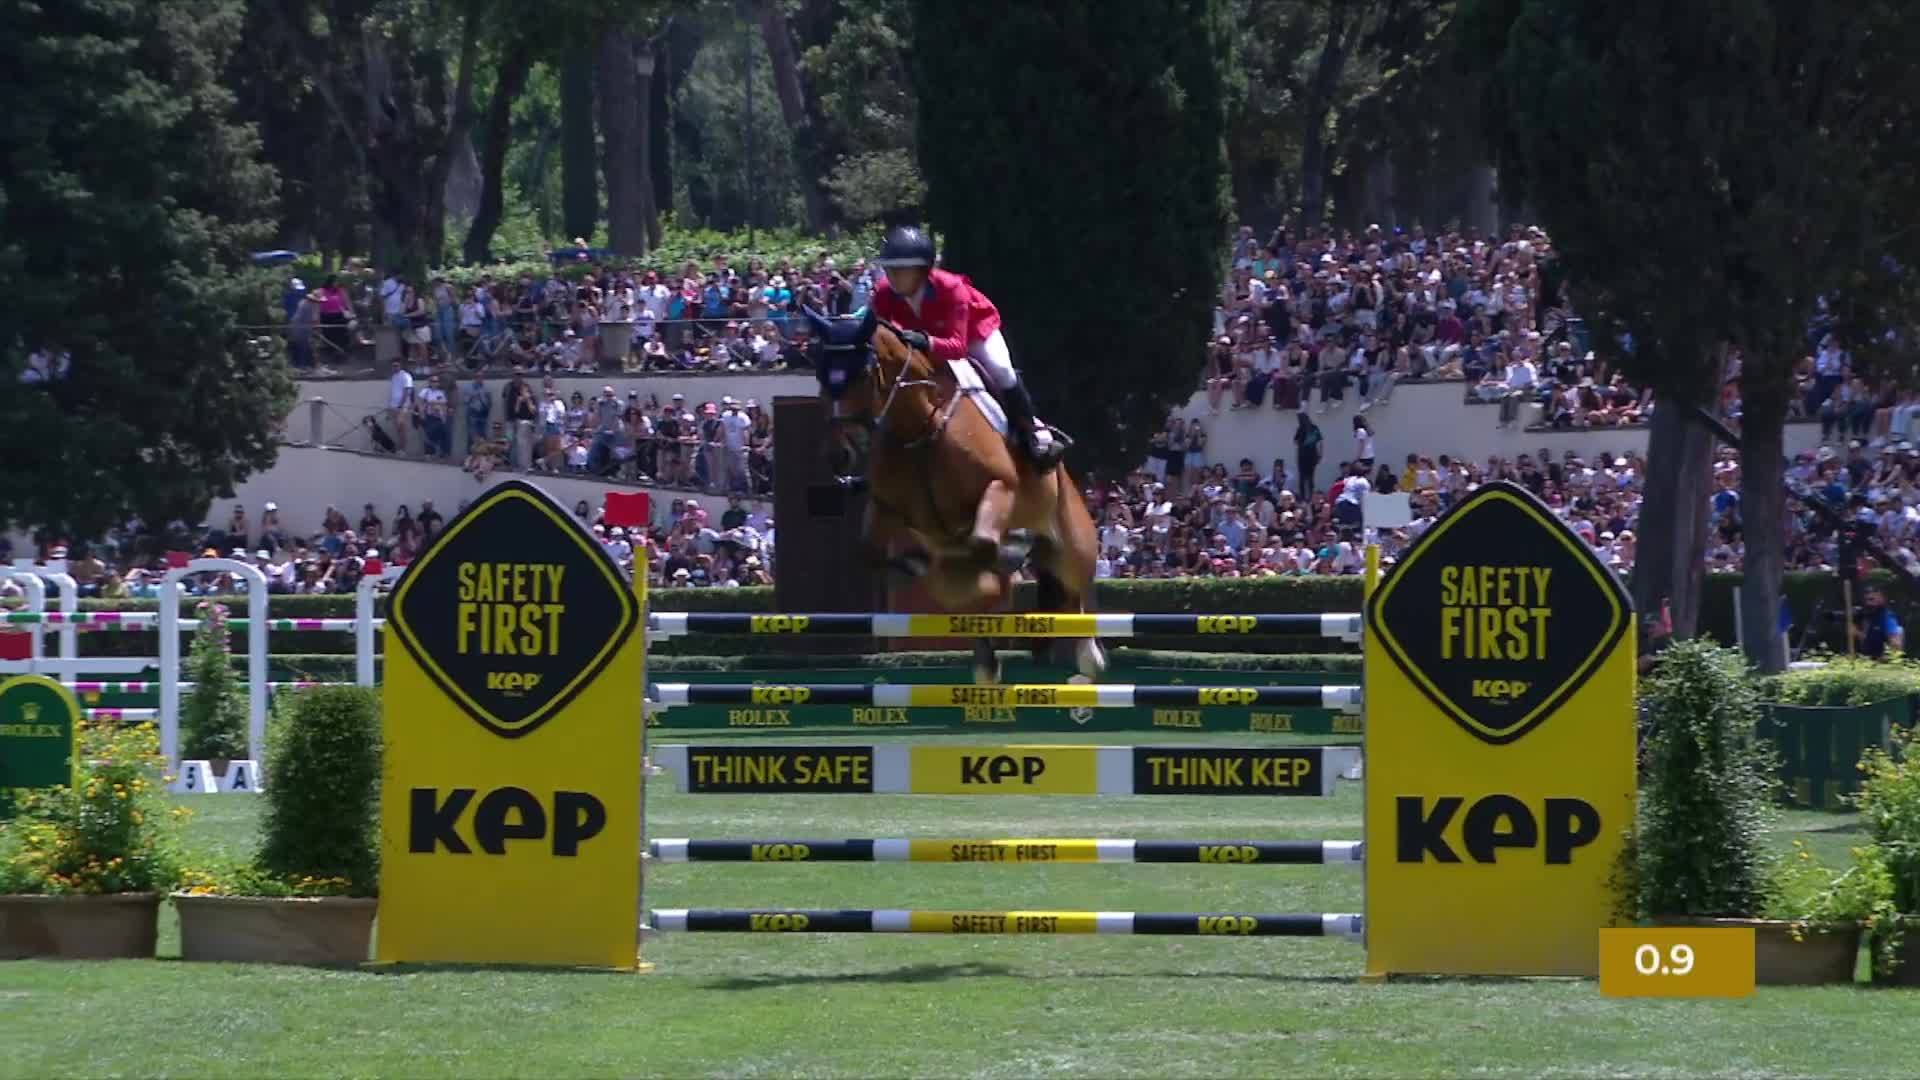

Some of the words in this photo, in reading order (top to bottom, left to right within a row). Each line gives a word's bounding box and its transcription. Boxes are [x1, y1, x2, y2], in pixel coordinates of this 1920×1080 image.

[458, 562, 565, 602] SAFETY
[1441, 566, 1552, 605] SAFETY
[457, 602, 565, 656] FIRST
[950, 616, 1003, 633] SAFETY
[1014, 616, 1055, 633] FIRST
[1441, 606, 1552, 660] FIRST
[951, 688, 1004, 704] SAFETY
[1016, 688, 1056, 704] FIRST
[729, 709, 791, 726] ROLEX
[852, 707, 909, 724] ROLEX
[185, 766, 197, 789] 5
[232, 766, 247, 789] A
[692, 755, 786, 785] THINK
[794, 755, 869, 785] SAFE
[1147, 757, 1243, 787] THINK
[1252, 757, 1311, 787] KEP
[951, 844, 1004, 861] SAFETY
[1016, 844, 1057, 861] FIRST
[951, 915, 1006, 934] SAFETY
[1016, 915, 1058, 934] FIRST
